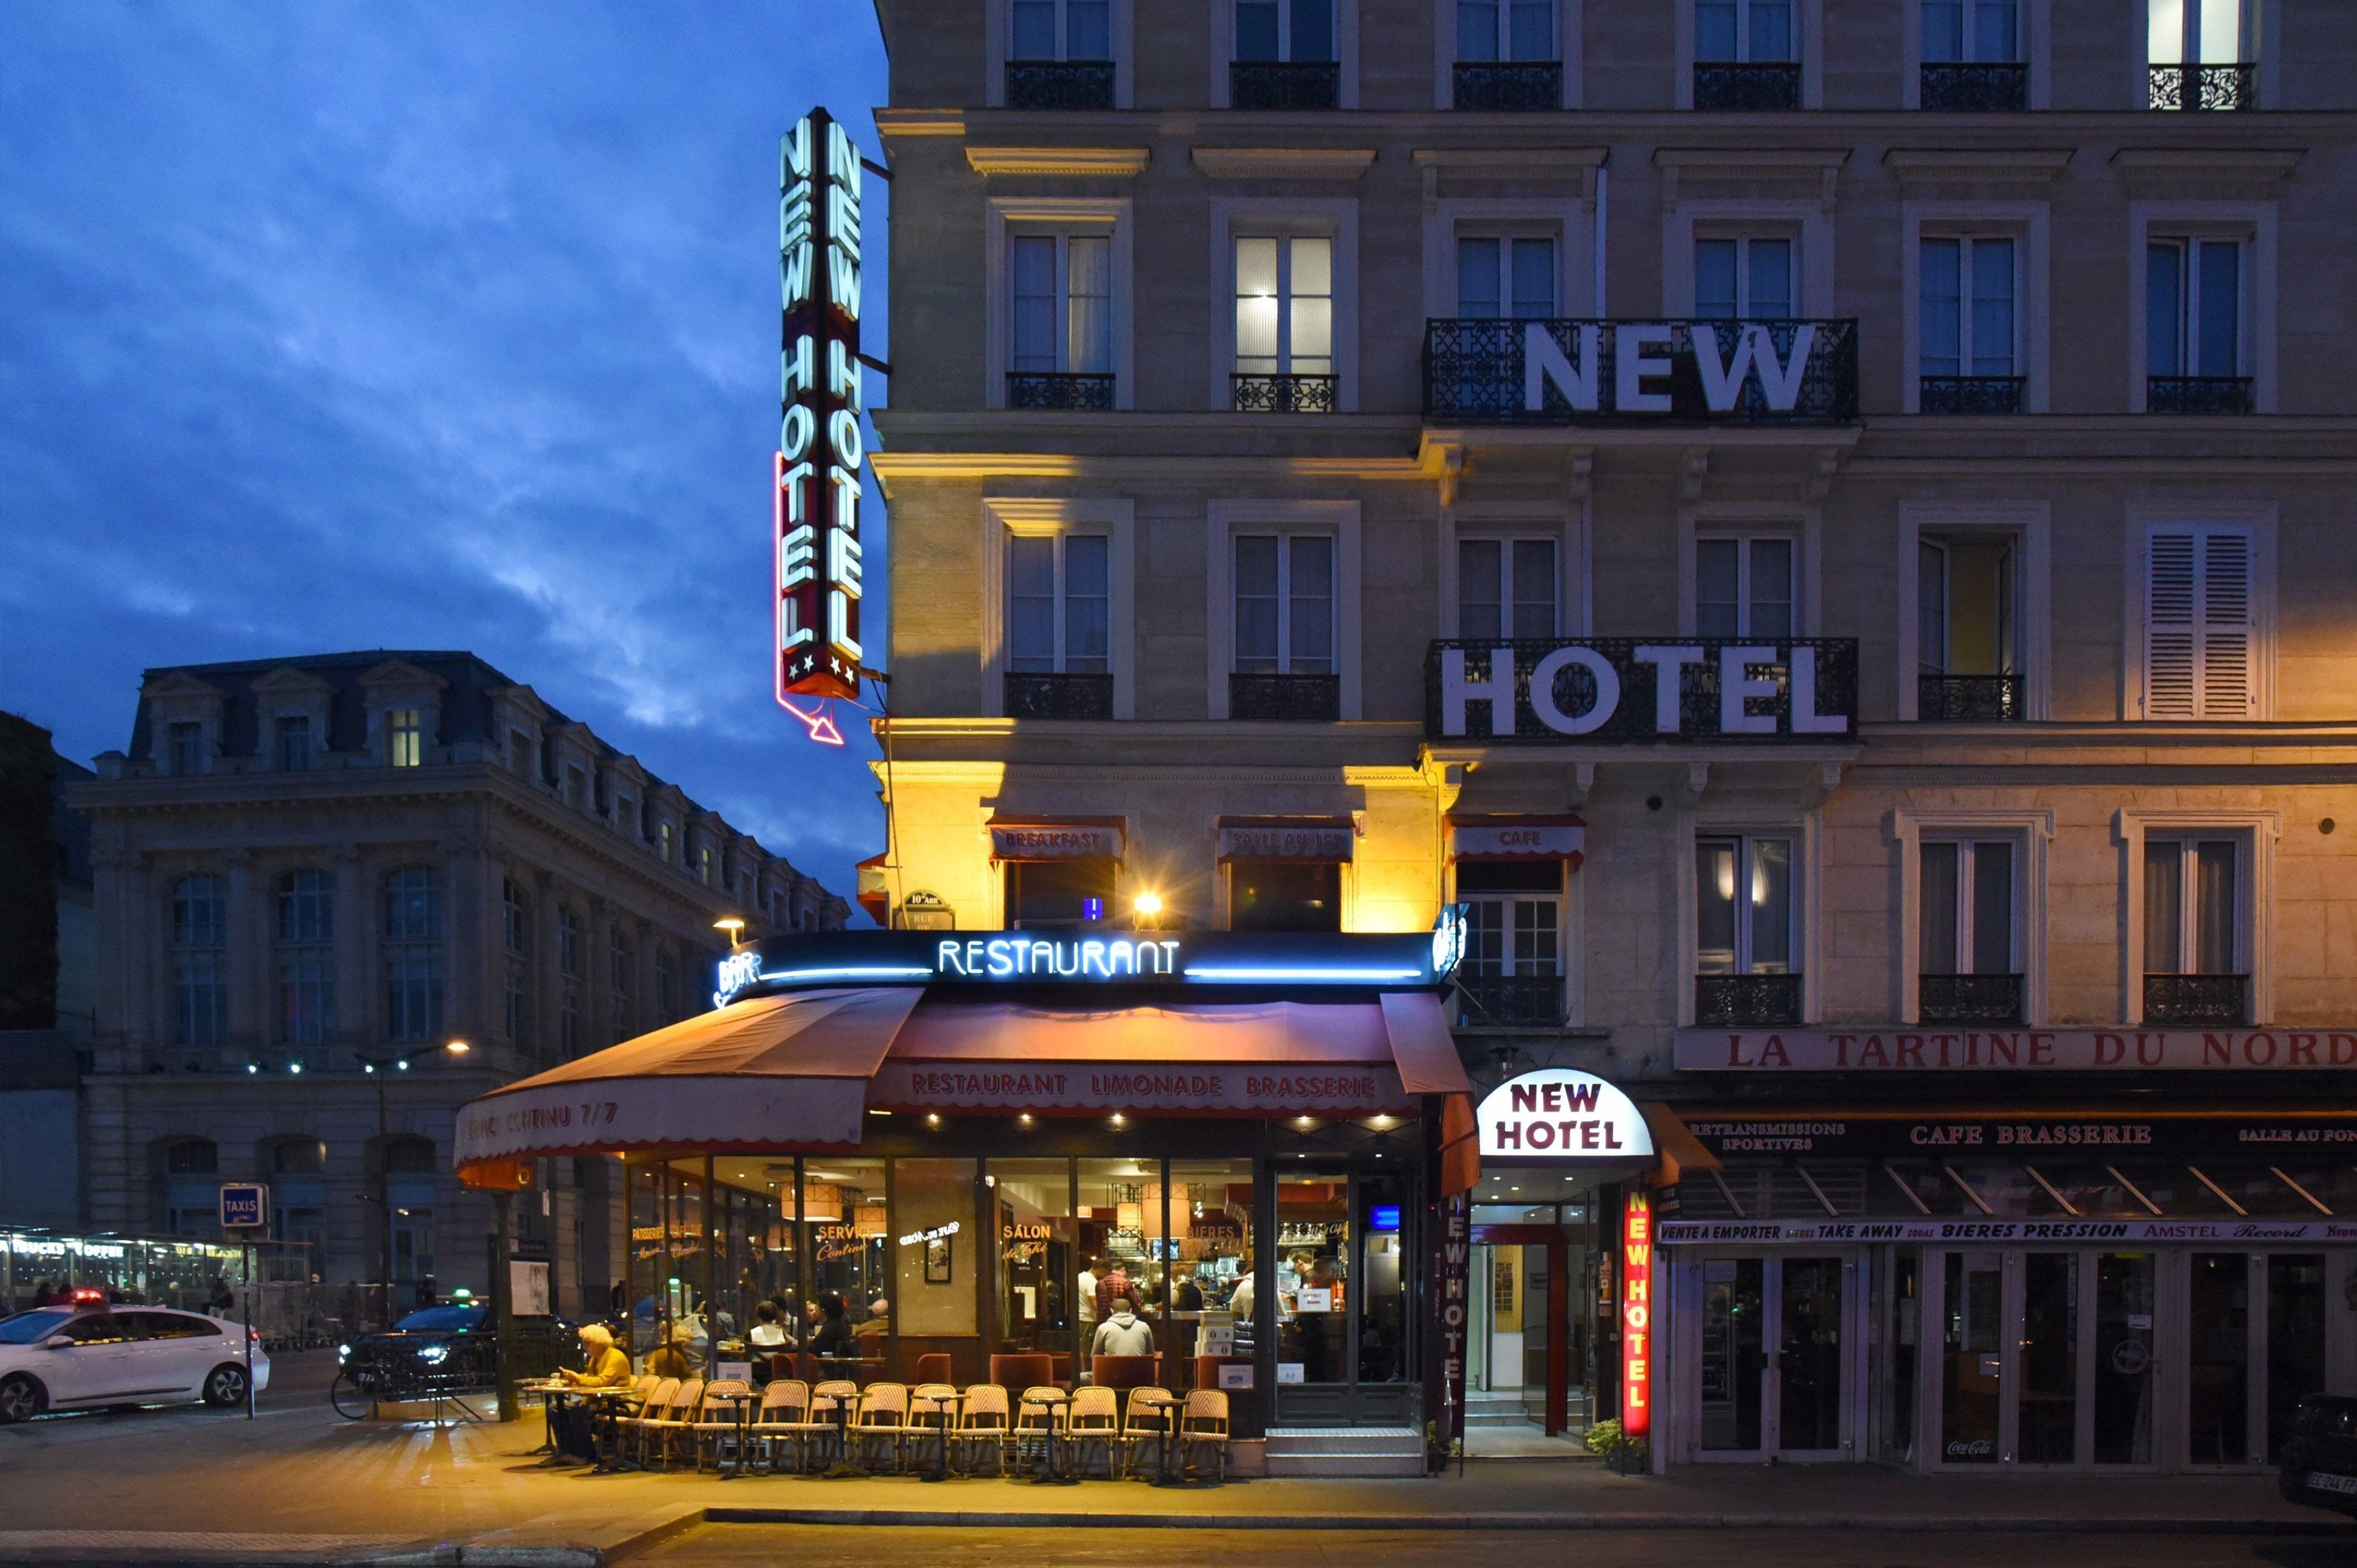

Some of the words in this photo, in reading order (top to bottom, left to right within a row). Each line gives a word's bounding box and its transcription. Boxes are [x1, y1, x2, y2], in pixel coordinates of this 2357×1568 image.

[778, 117, 814, 315] NEW
[828, 120, 861, 322] NEW
[1525, 324, 1817, 413] NEW
[780, 334, 815, 653] HOTEL
[828, 338, 863, 663] HOTEL
[1441, 645, 1848, 736] HOTEL
[1005, 831, 1101, 848] BREAKFAST
[1284, 832, 1308, 848] AU
[1498, 831, 1541, 847] CAFE
[913, 915, 934, 923] RUE
[939, 940, 1181, 976] RESTAURANT
[1727, 1033, 1792, 1068] LA
[1828, 1032, 2057, 1067] TARTINE
[2092, 1031, 2166, 1066] DU
[2202, 1031, 2357, 1066] NORD
[911, 1072, 1067, 1095] RESTAURANT
[1091, 1073, 1222, 1097] LIMONADE
[1246, 1075, 1375, 1098] BRASSERIE
[1510, 1082, 1602, 1113] NEW
[580, 1102, 618, 1127] 7/7
[1495, 1120, 1623, 1150] HOTEL
[1690, 1122, 1846, 1136] RETRANSMISSIONS
[1910, 1125, 1983, 1145] CAFE
[1997, 1125, 2152, 1144] BRASSERIE
[2238, 1129, 2292, 1142] SALLE
[2296, 1129, 2321, 1142] AU
[1722, 1138, 1814, 1151] SPORTIVES
[225, 1199, 257, 1213] TAXIS
[818, 1225, 875, 1240] SERVICE
[1003, 1225, 1051, 1239] SALON
[1445, 1193, 1467, 1264] NEW
[1626, 1192, 1649, 1266] NEW
[1661, 1225, 1700, 1239] VENTE
[1700, 1226, 1709, 1238] A
[1712, 1225, 1781, 1239] EMPORTER
[1818, 1225, 1855, 1238] TAKE
[1859, 1225, 1903, 1238] AWAY
[1906, 1229, 1934, 1238] SODAS
[1941, 1224, 2016, 1238] BIERES
[2023, 1223, 2127, 1238] PRESSION
[2143, 1225, 2221, 1238] AMSTEL
[2232, 1224, 2309, 1239] Record
[816, 1243, 869, 1262] Continu
[1444, 1279, 1464, 1406] HOTEL
[1628, 1280, 1648, 1407] HOTEL
